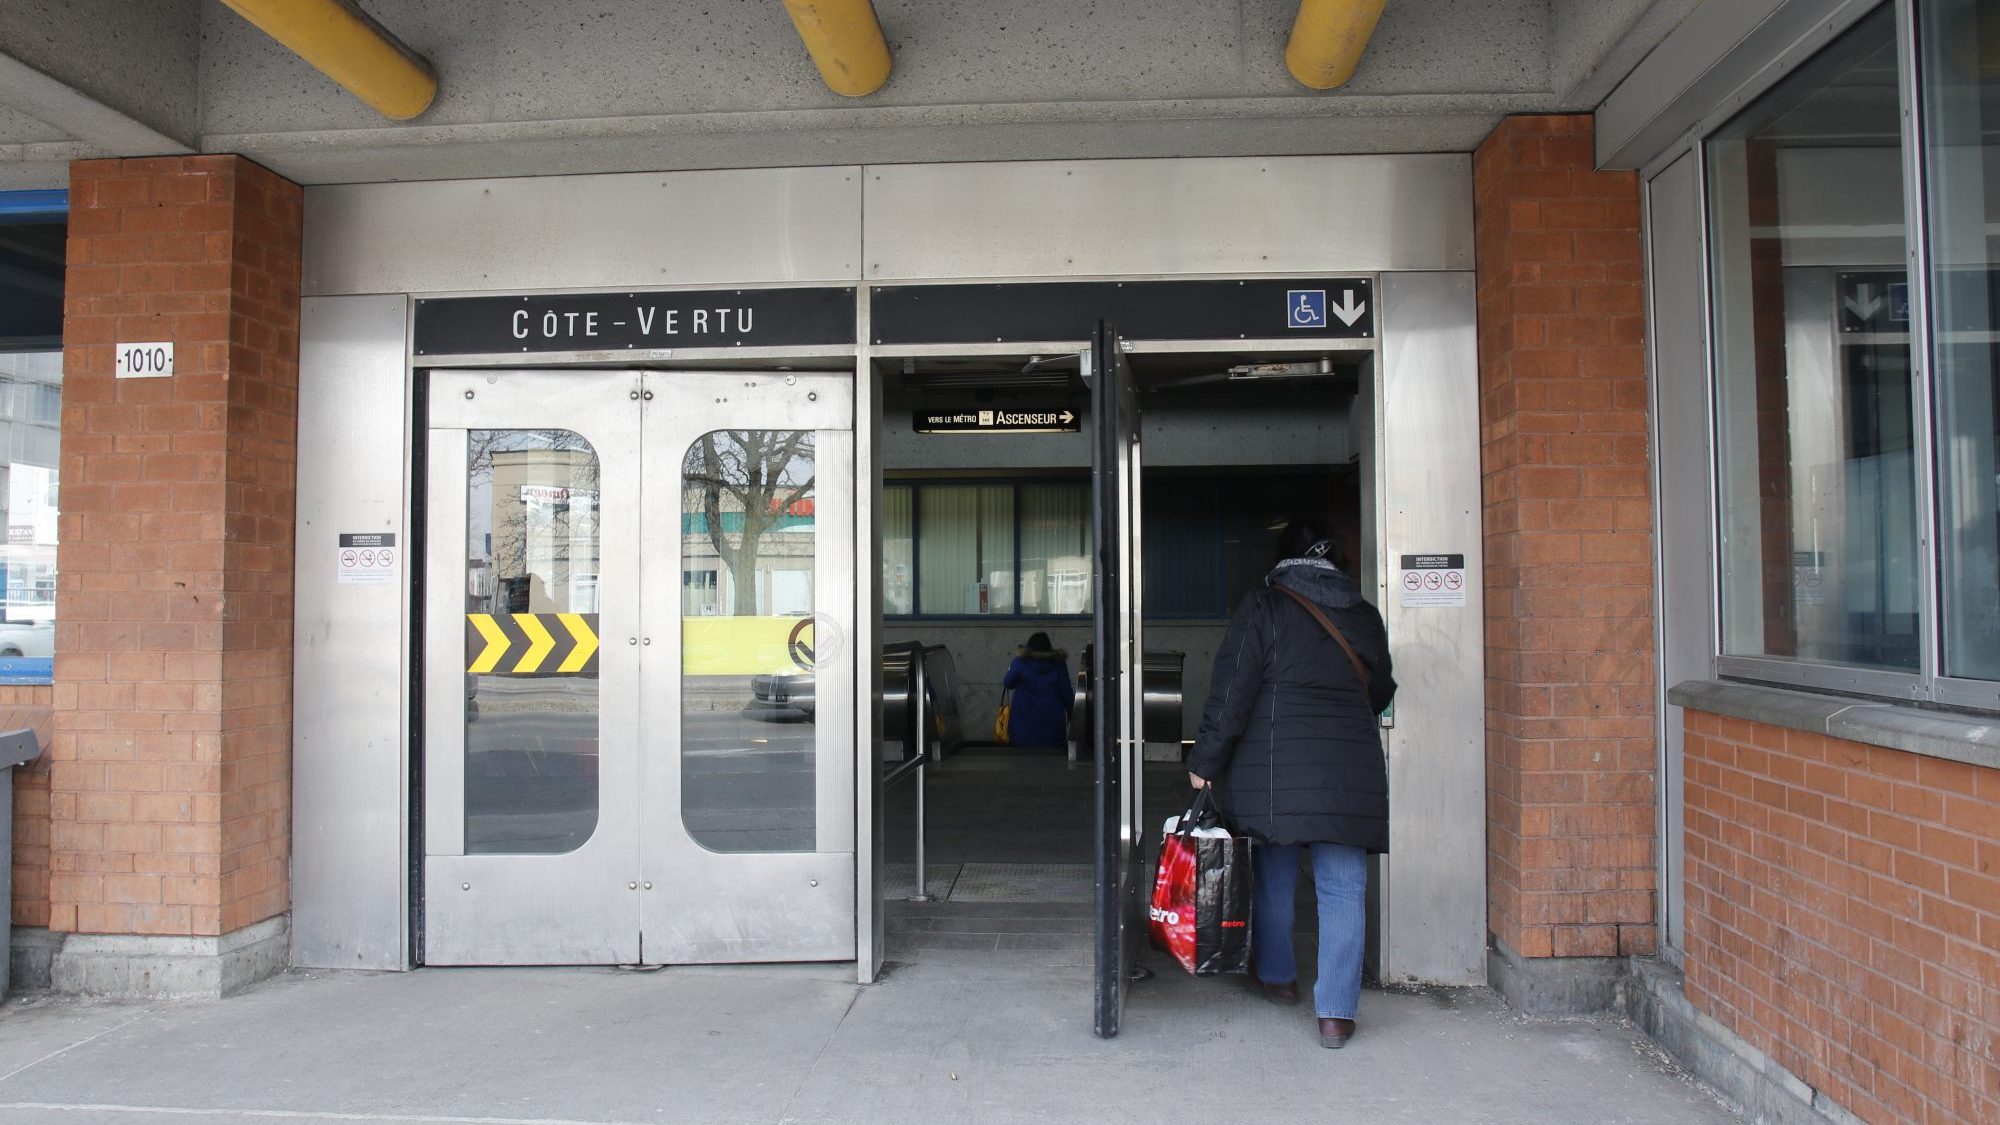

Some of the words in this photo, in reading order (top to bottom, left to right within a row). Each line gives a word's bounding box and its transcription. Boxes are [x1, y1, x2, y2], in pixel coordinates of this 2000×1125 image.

[124, 348, 166, 372] 1010
[928, 416, 943, 424] VERS
[953, 413, 977, 423] MÉTRO
[996, 410, 1057, 425] ASCENSEUR
